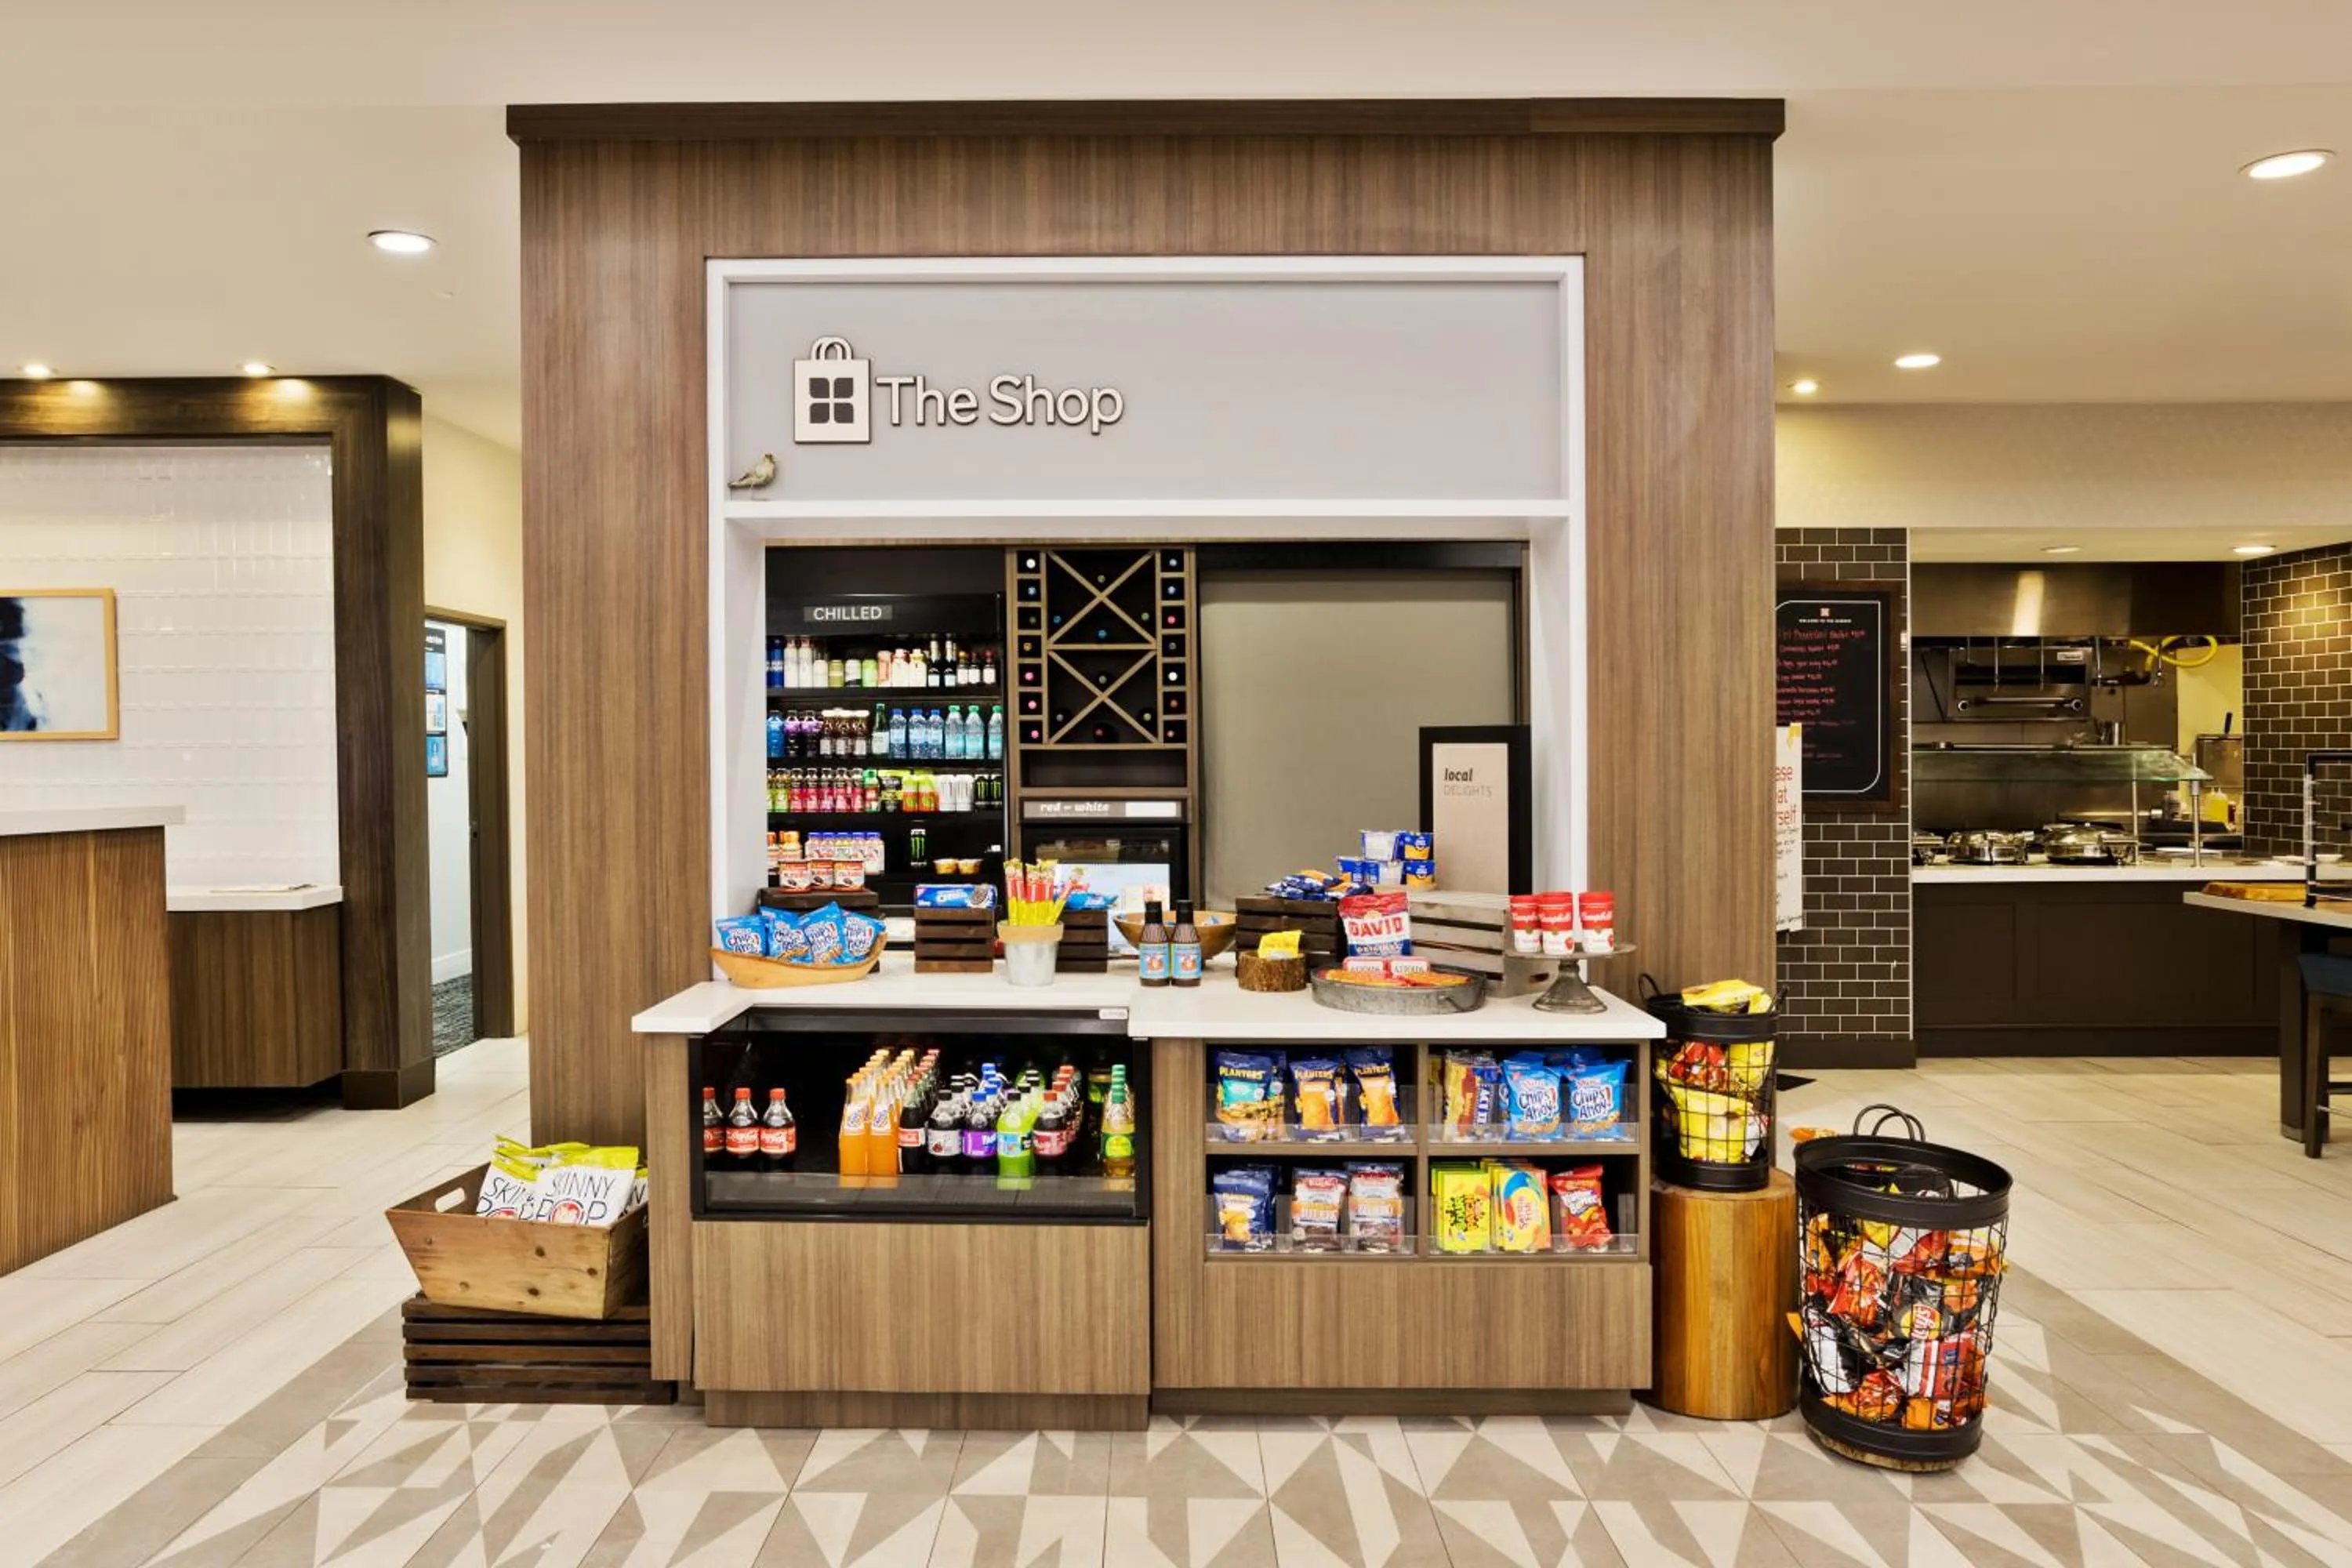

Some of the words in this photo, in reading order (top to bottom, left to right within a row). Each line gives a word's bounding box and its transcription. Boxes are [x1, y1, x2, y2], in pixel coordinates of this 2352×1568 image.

[876, 376, 979, 426] The
[989, 374, 1124, 435] Shop
[813, 606, 883, 621] CHILLED
[1444, 768, 1474, 782] local
[1443, 785, 1494, 799] DELIGHTS
[1040, 802, 1062, 812] red
[1075, 802, 1110, 812] white
[1348, 916, 1404, 937] DAVID
[1220, 1067, 1264, 1080] PLANTERS
[1296, 1069, 1334, 1080] PLANTERS
[1355, 1065, 1391, 1076] PLANTERS
[1519, 1089, 1552, 1109] Chips
[1573, 1088, 1606, 1107] Chips
